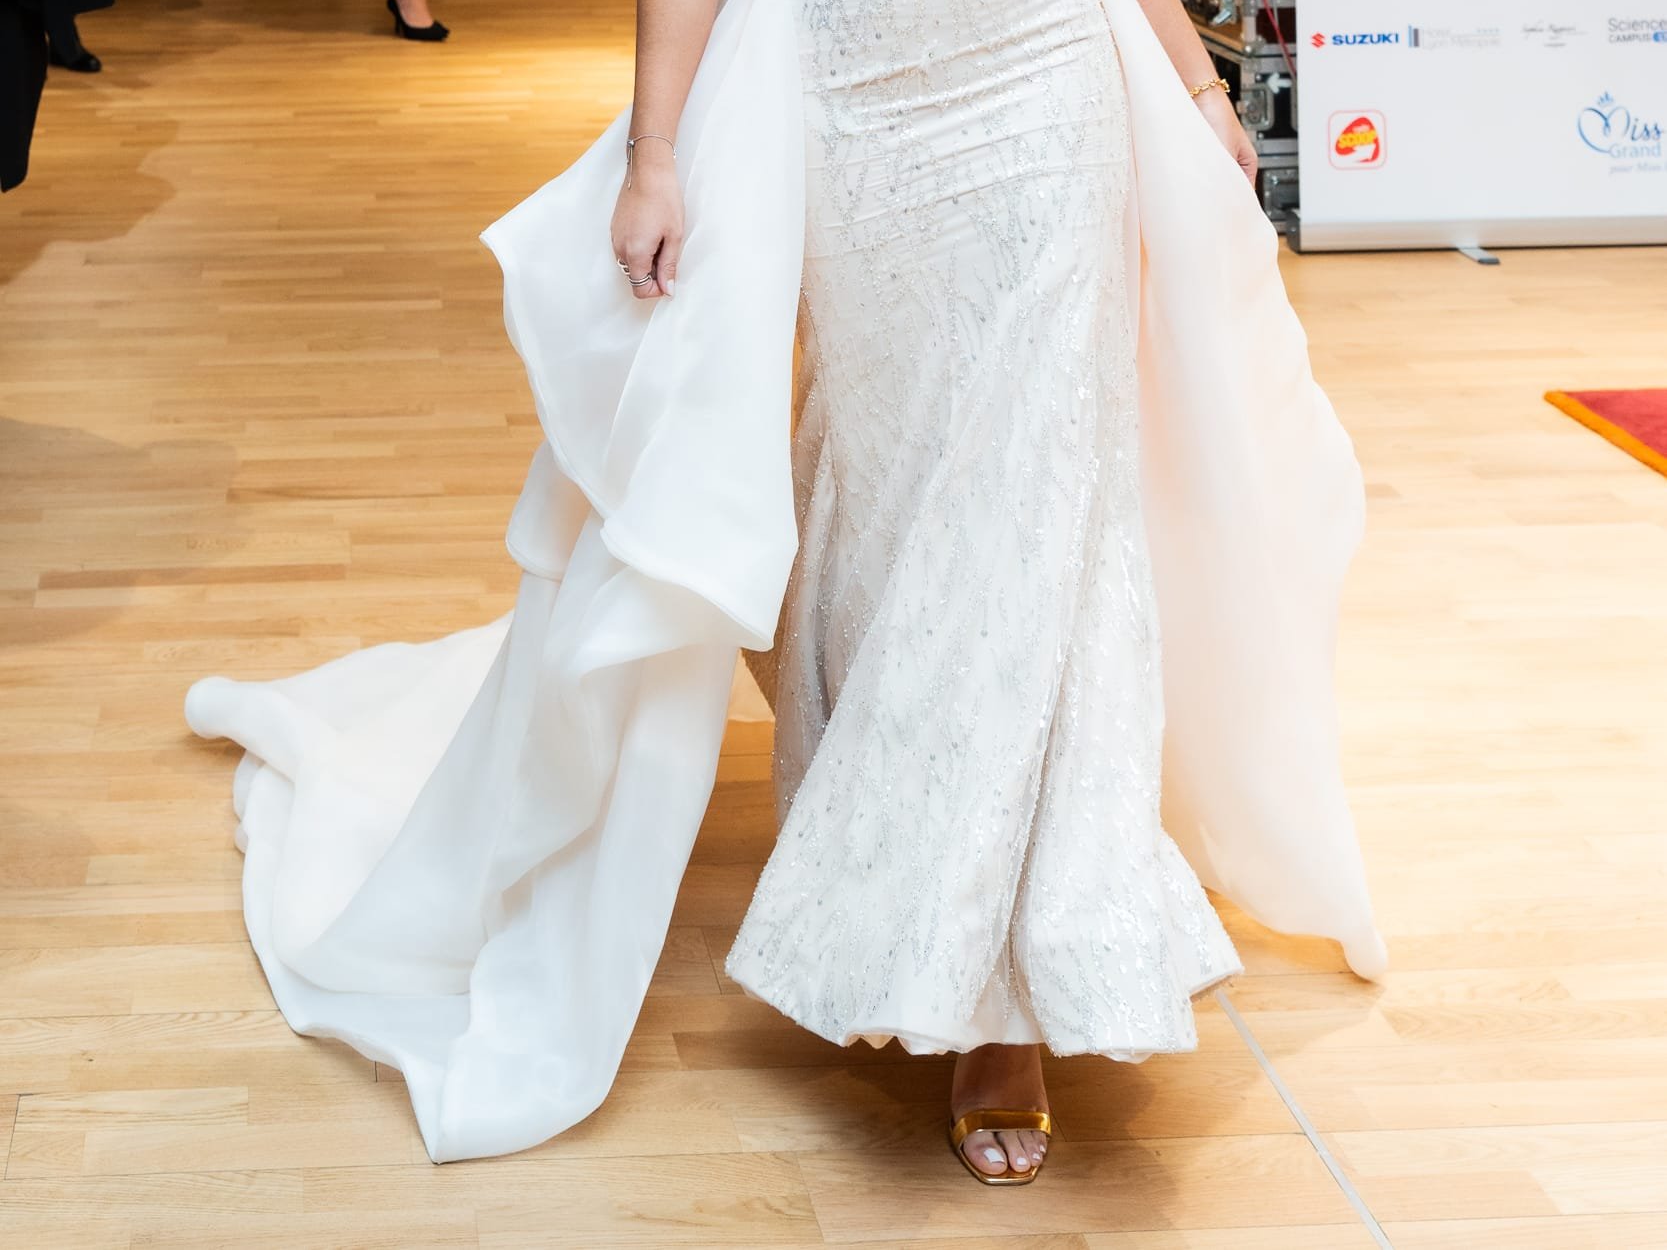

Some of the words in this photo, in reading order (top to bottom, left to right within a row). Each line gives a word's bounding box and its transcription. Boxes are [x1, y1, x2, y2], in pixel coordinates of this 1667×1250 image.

[1332, 33, 1399, 46] SUZUKI
[1578, 105, 1664, 154] Miss
[1609, 142, 1661, 158] Grand
